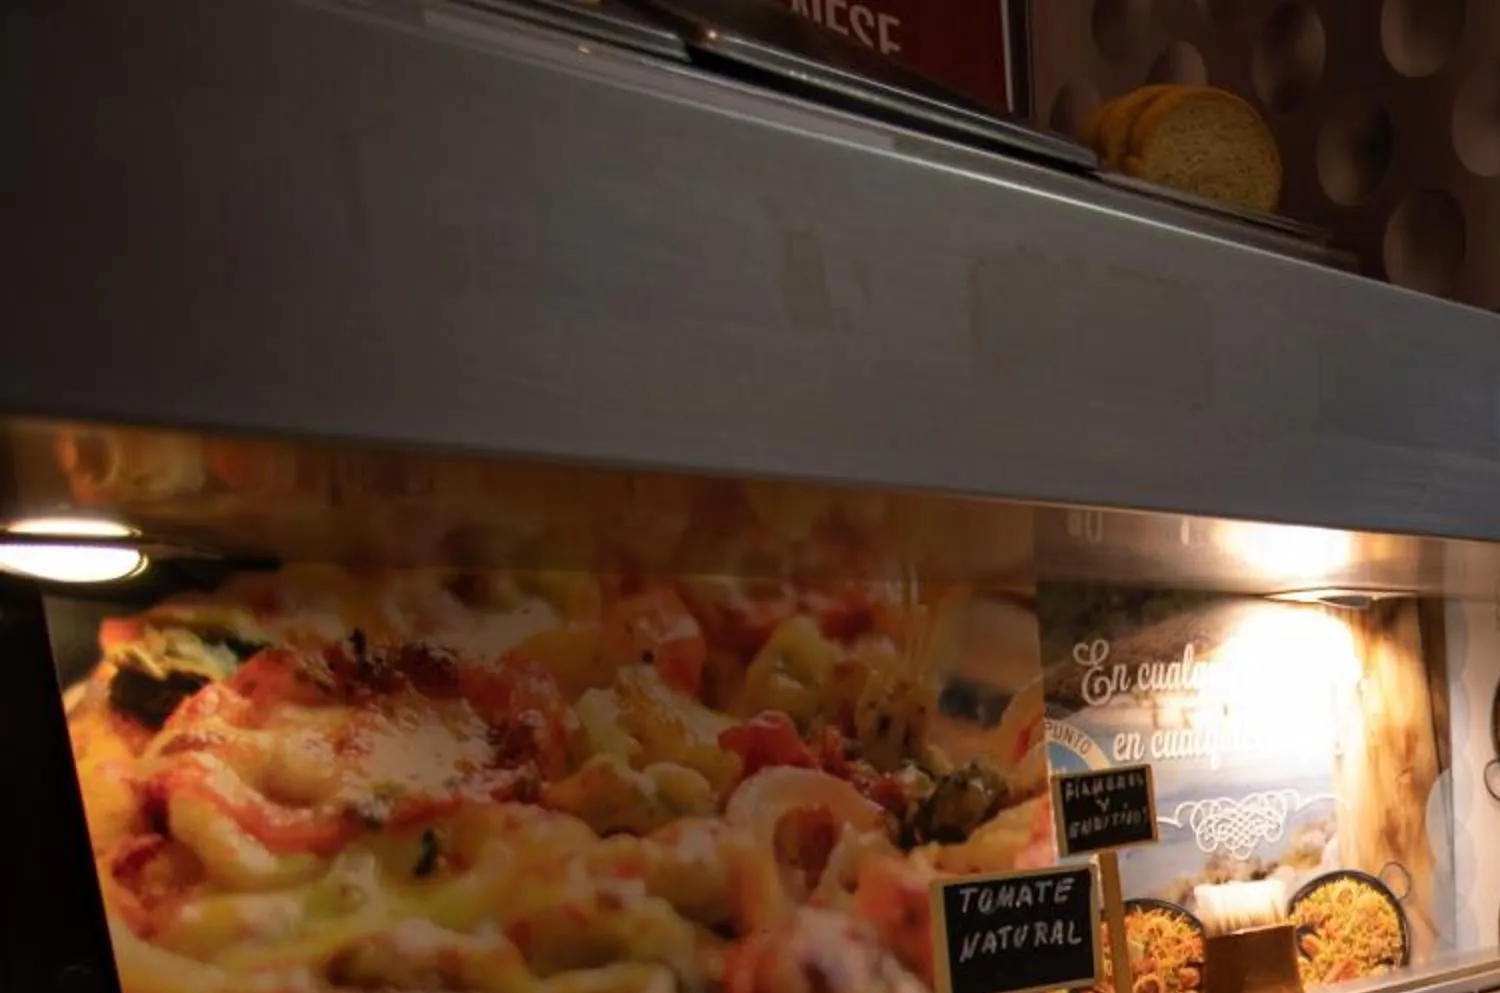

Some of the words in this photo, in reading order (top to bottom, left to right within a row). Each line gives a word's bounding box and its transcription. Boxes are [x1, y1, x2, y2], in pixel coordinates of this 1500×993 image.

[1073, 639, 1130, 706] En
[1113, 731, 1145, 761] en
[960, 877, 1076, 914] TOMATE
[960, 920, 1083, 963] NATURAL
